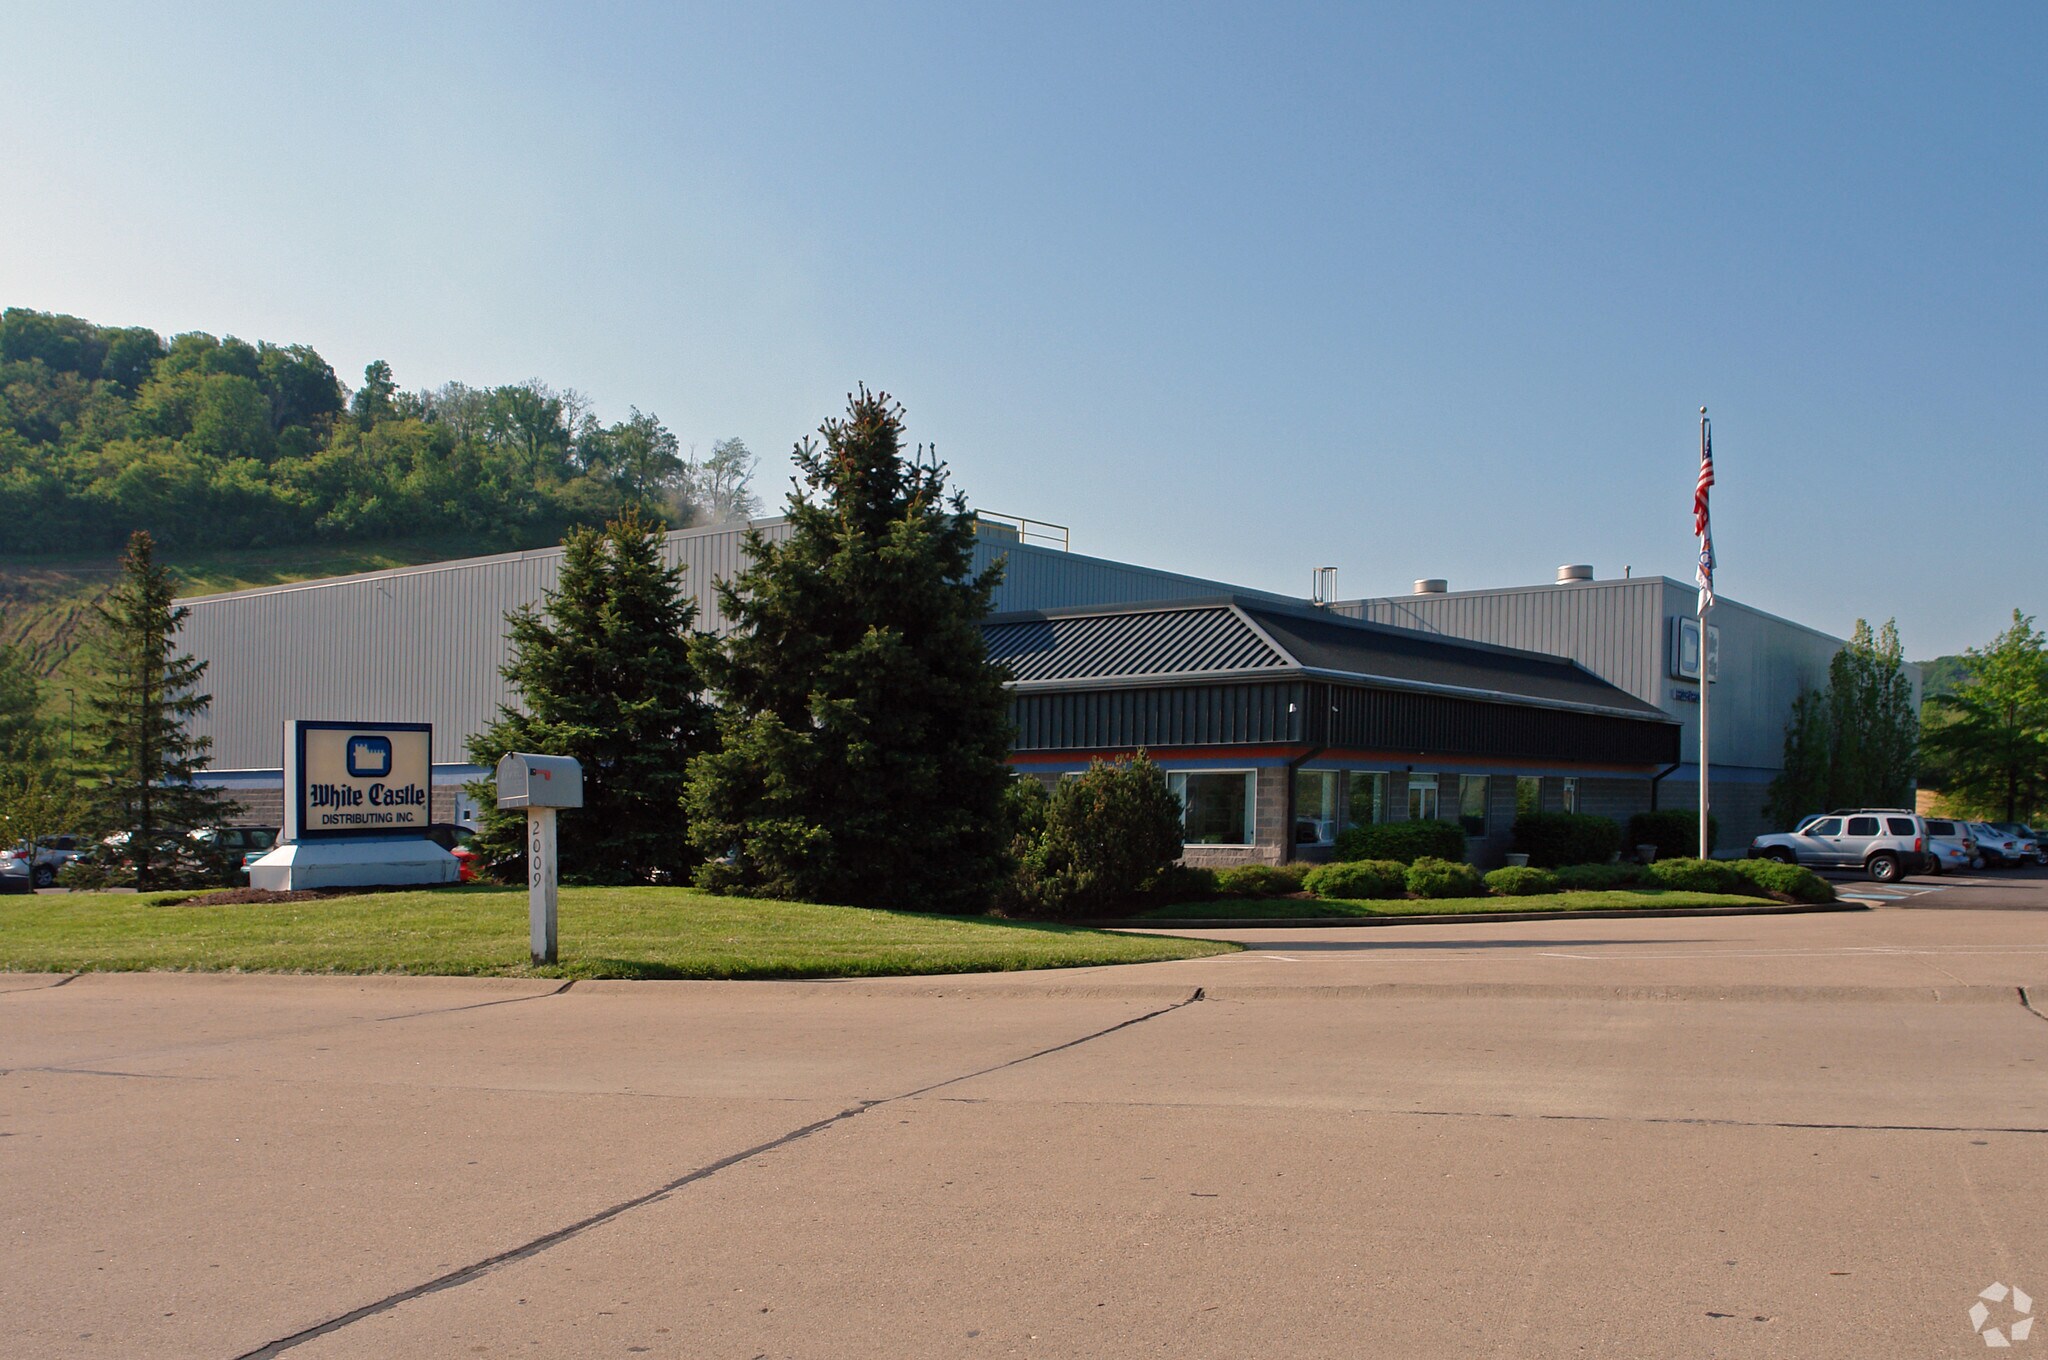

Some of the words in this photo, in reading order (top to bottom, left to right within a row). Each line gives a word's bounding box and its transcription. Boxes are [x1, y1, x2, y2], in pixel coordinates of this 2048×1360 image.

[310, 783, 363, 811] White
[368, 783, 425, 807] Castle
[322, 812, 393, 825] DISTRIBUTING
[396, 812, 414, 823] INC.
[532, 820, 542, 888] 2009
